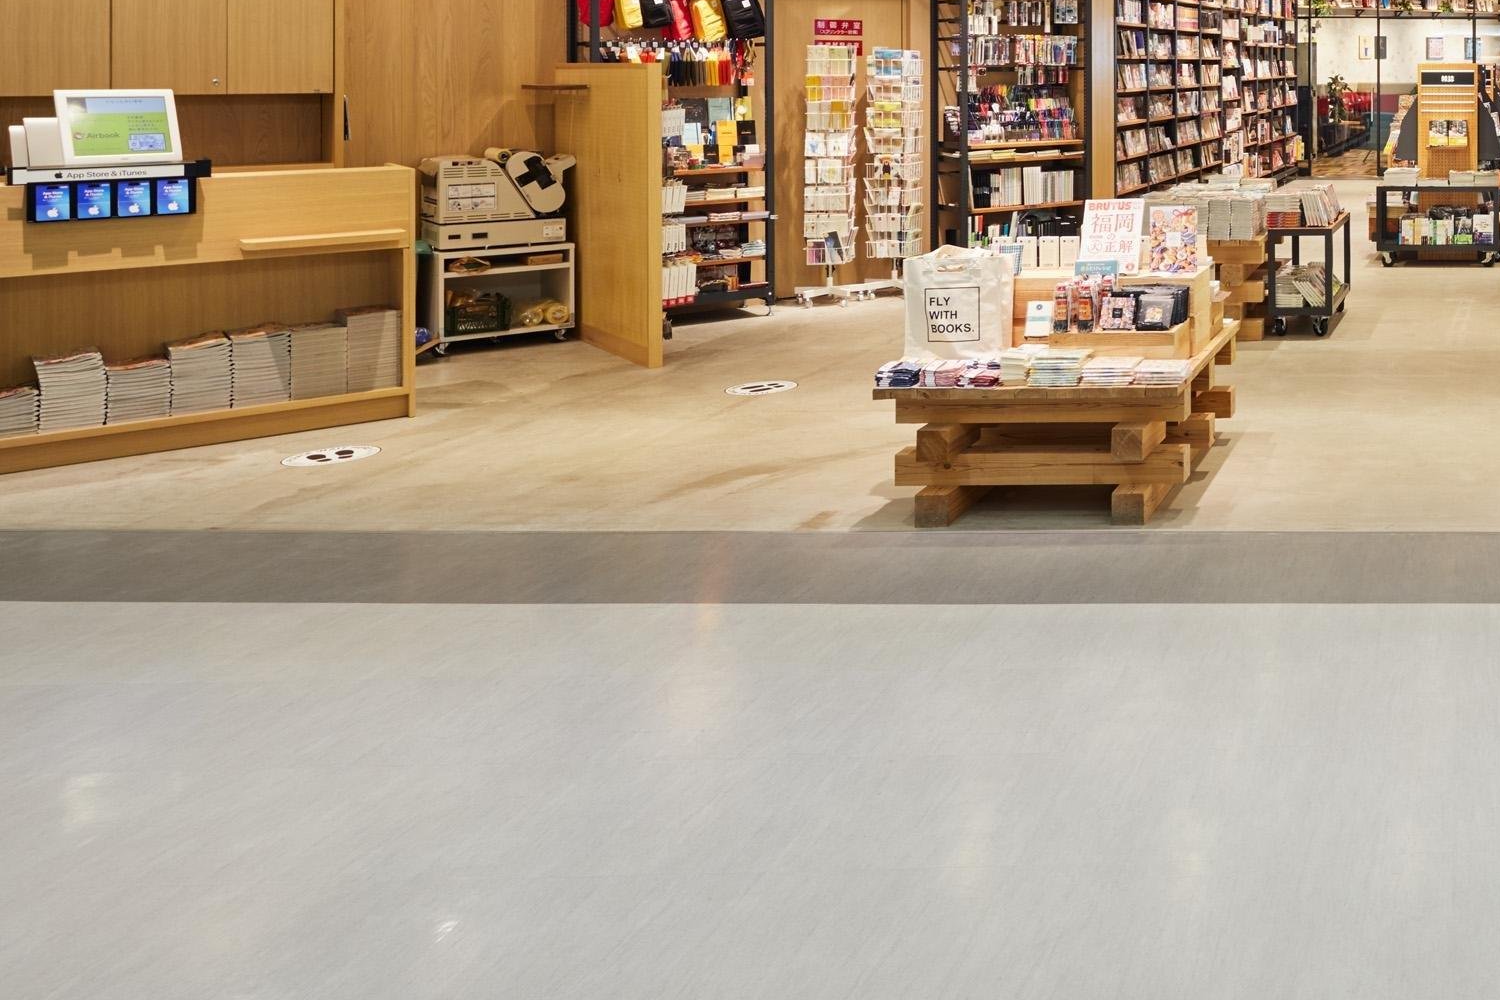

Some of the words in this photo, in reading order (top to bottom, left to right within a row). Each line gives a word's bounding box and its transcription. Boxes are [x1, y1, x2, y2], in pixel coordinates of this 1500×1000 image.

[1088, 201, 1132, 211] BRUTUS
[1092, 213, 1135, 233] 福岡
[929, 297, 950, 306] FLY
[929, 310, 957, 320] WITH
[931, 323, 974, 333] BOOKS.
